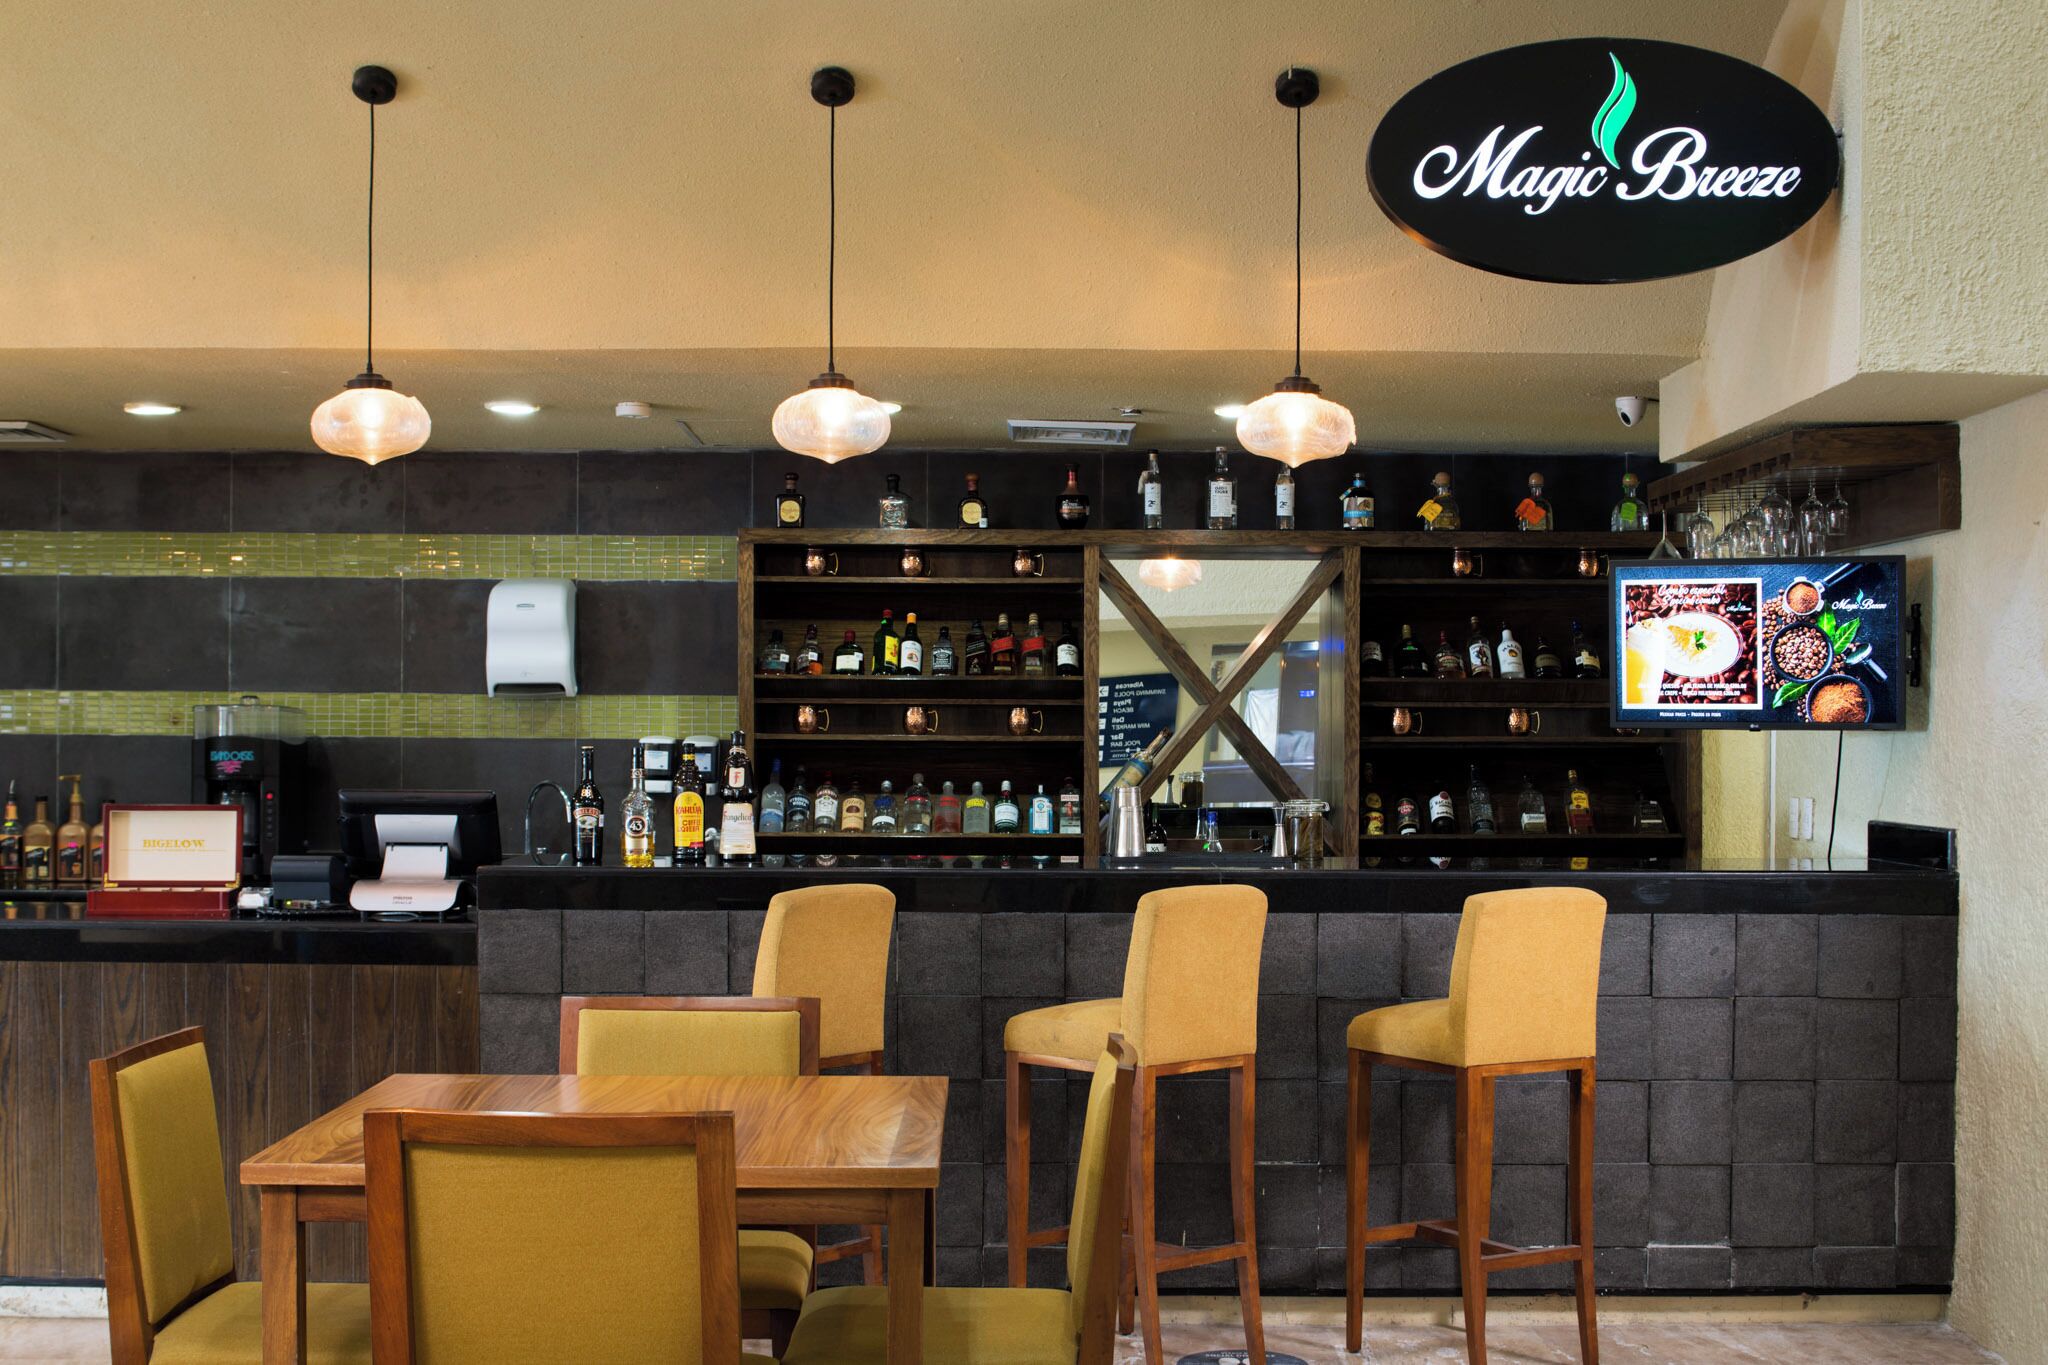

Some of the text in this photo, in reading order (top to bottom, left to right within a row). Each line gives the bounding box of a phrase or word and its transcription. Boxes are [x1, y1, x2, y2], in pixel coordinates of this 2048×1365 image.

[1413, 124, 1801, 215] Magic Breeze
[1658, 584, 1689, 598] Combo
[1831, 598, 1859, 612] Magic
[629, 820, 643, 832] 43
[143, 839, 205, 849] BIGELOW
